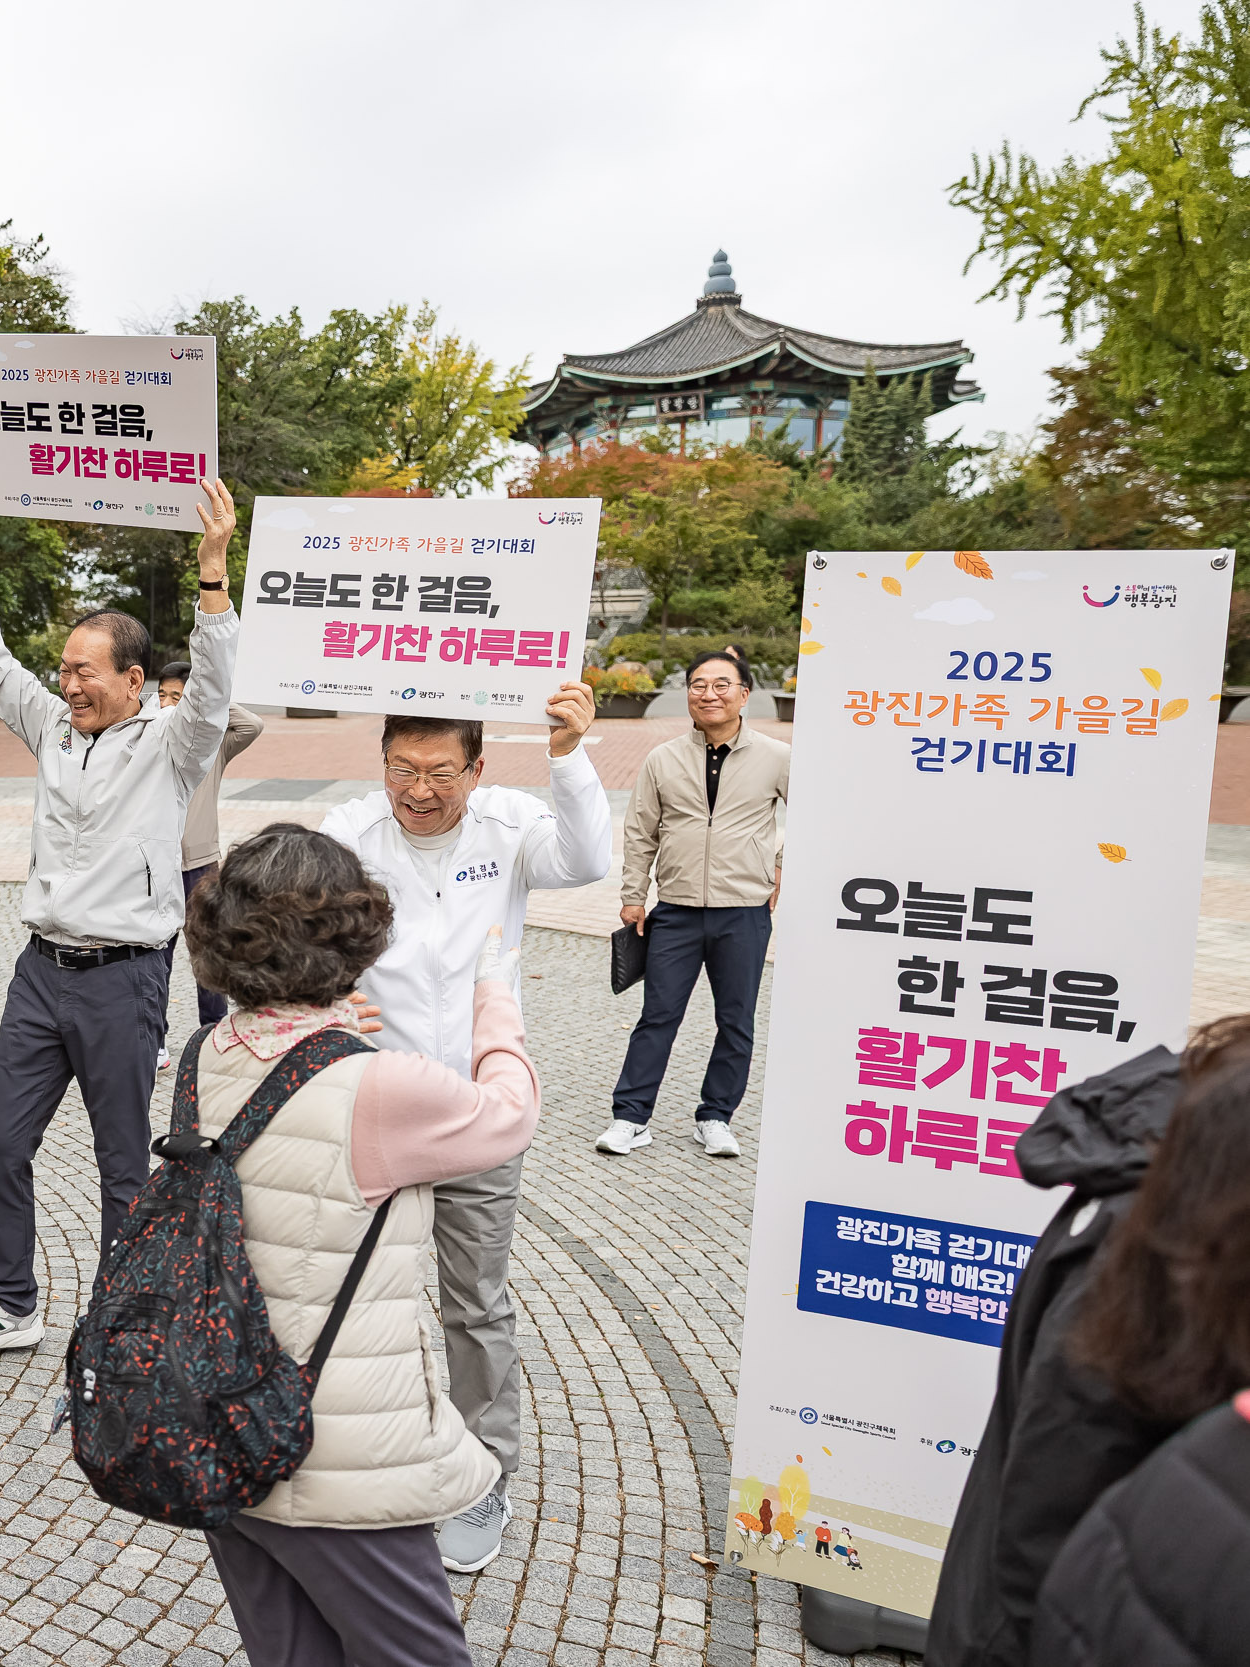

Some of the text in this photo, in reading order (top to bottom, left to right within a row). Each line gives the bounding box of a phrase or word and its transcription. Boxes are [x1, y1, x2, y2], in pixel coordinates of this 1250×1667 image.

[1, 368, 172, 386] 2025 광진가족 가을길 걷기대회
[57, 401, 85, 435] 한
[91, 403, 154, 442] 걸음,
[29, 443, 206, 486] 활기찬 하루로!
[302, 535, 536, 556] 2025 광진가족 가을길 걷기대회
[256, 570, 501, 619] 오늘도 한 걸음,
[1124, 592, 1177, 609] 행복광진
[322, 620, 571, 669] 활기찬 하루로!
[946, 650, 1052, 683] 2025
[418, 690, 445, 699] 광진구
[843, 690, 1160, 736] 광진가족 가을길
[911, 737, 1077, 777] 걷기대회
[836, 877, 1034, 946] 오늘도
[897, 954, 1137, 1042] 한 걸음,
[855, 1026, 1068, 1108] 활기찬
[836, 1215, 1035, 1270] 광진가족 걷기대
[891, 1253, 1015, 1296] 함께 해요!
[815, 1269, 1009, 1326] 건강하고 행복한
[822, 1413, 896, 1435] 서울특별시 광진구체육회
[920, 1437, 933, 1446] 후원
